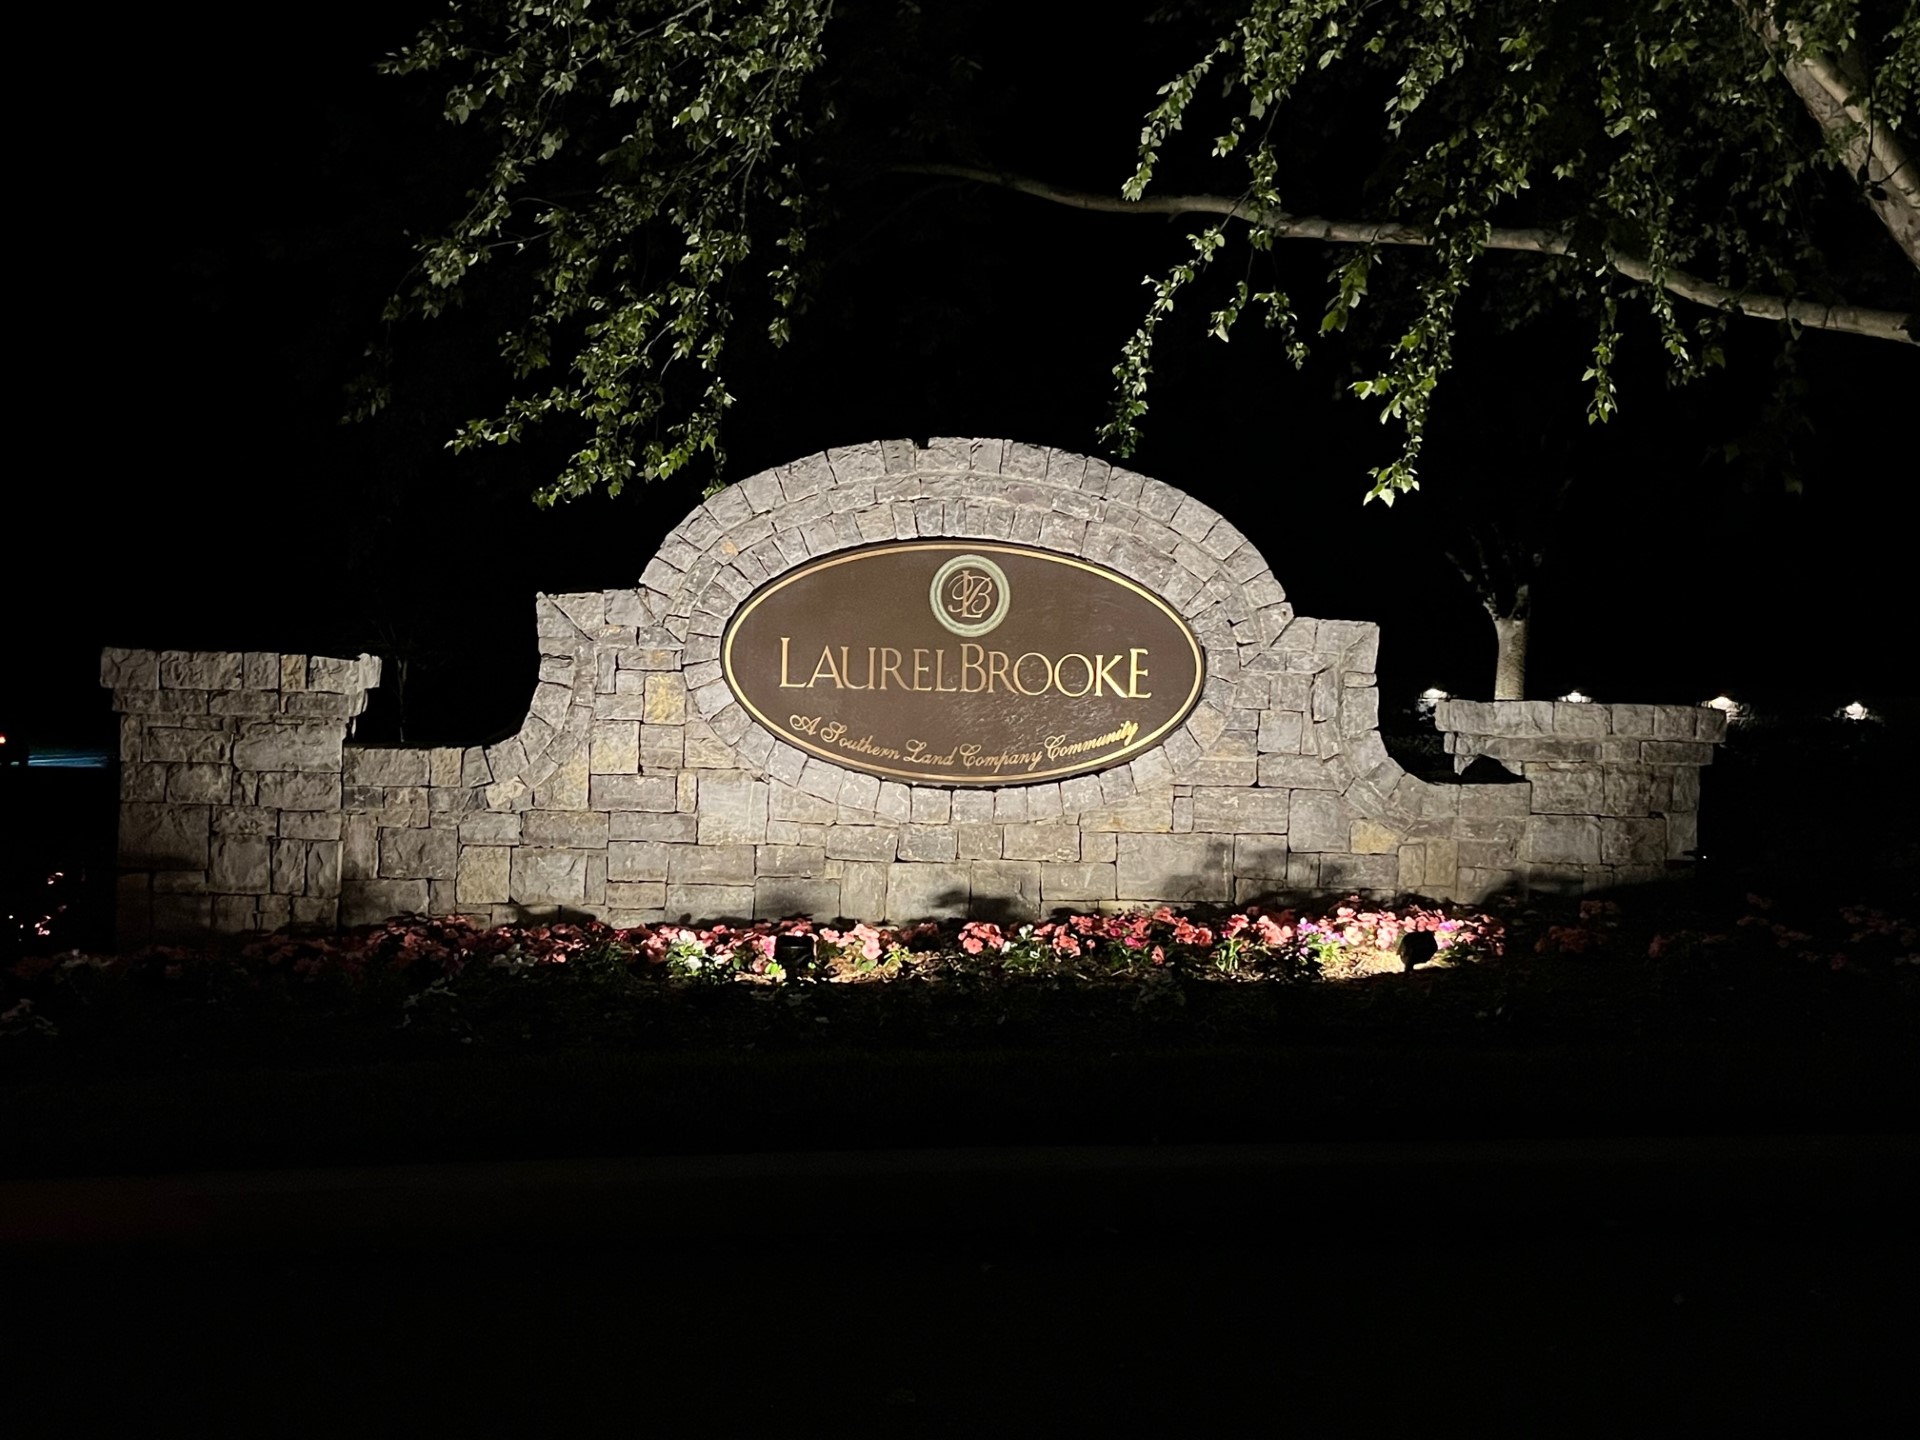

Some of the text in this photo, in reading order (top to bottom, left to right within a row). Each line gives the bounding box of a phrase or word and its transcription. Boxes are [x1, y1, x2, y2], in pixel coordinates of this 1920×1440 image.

[789, 714, 1139, 774] A Southern Land Company Community
